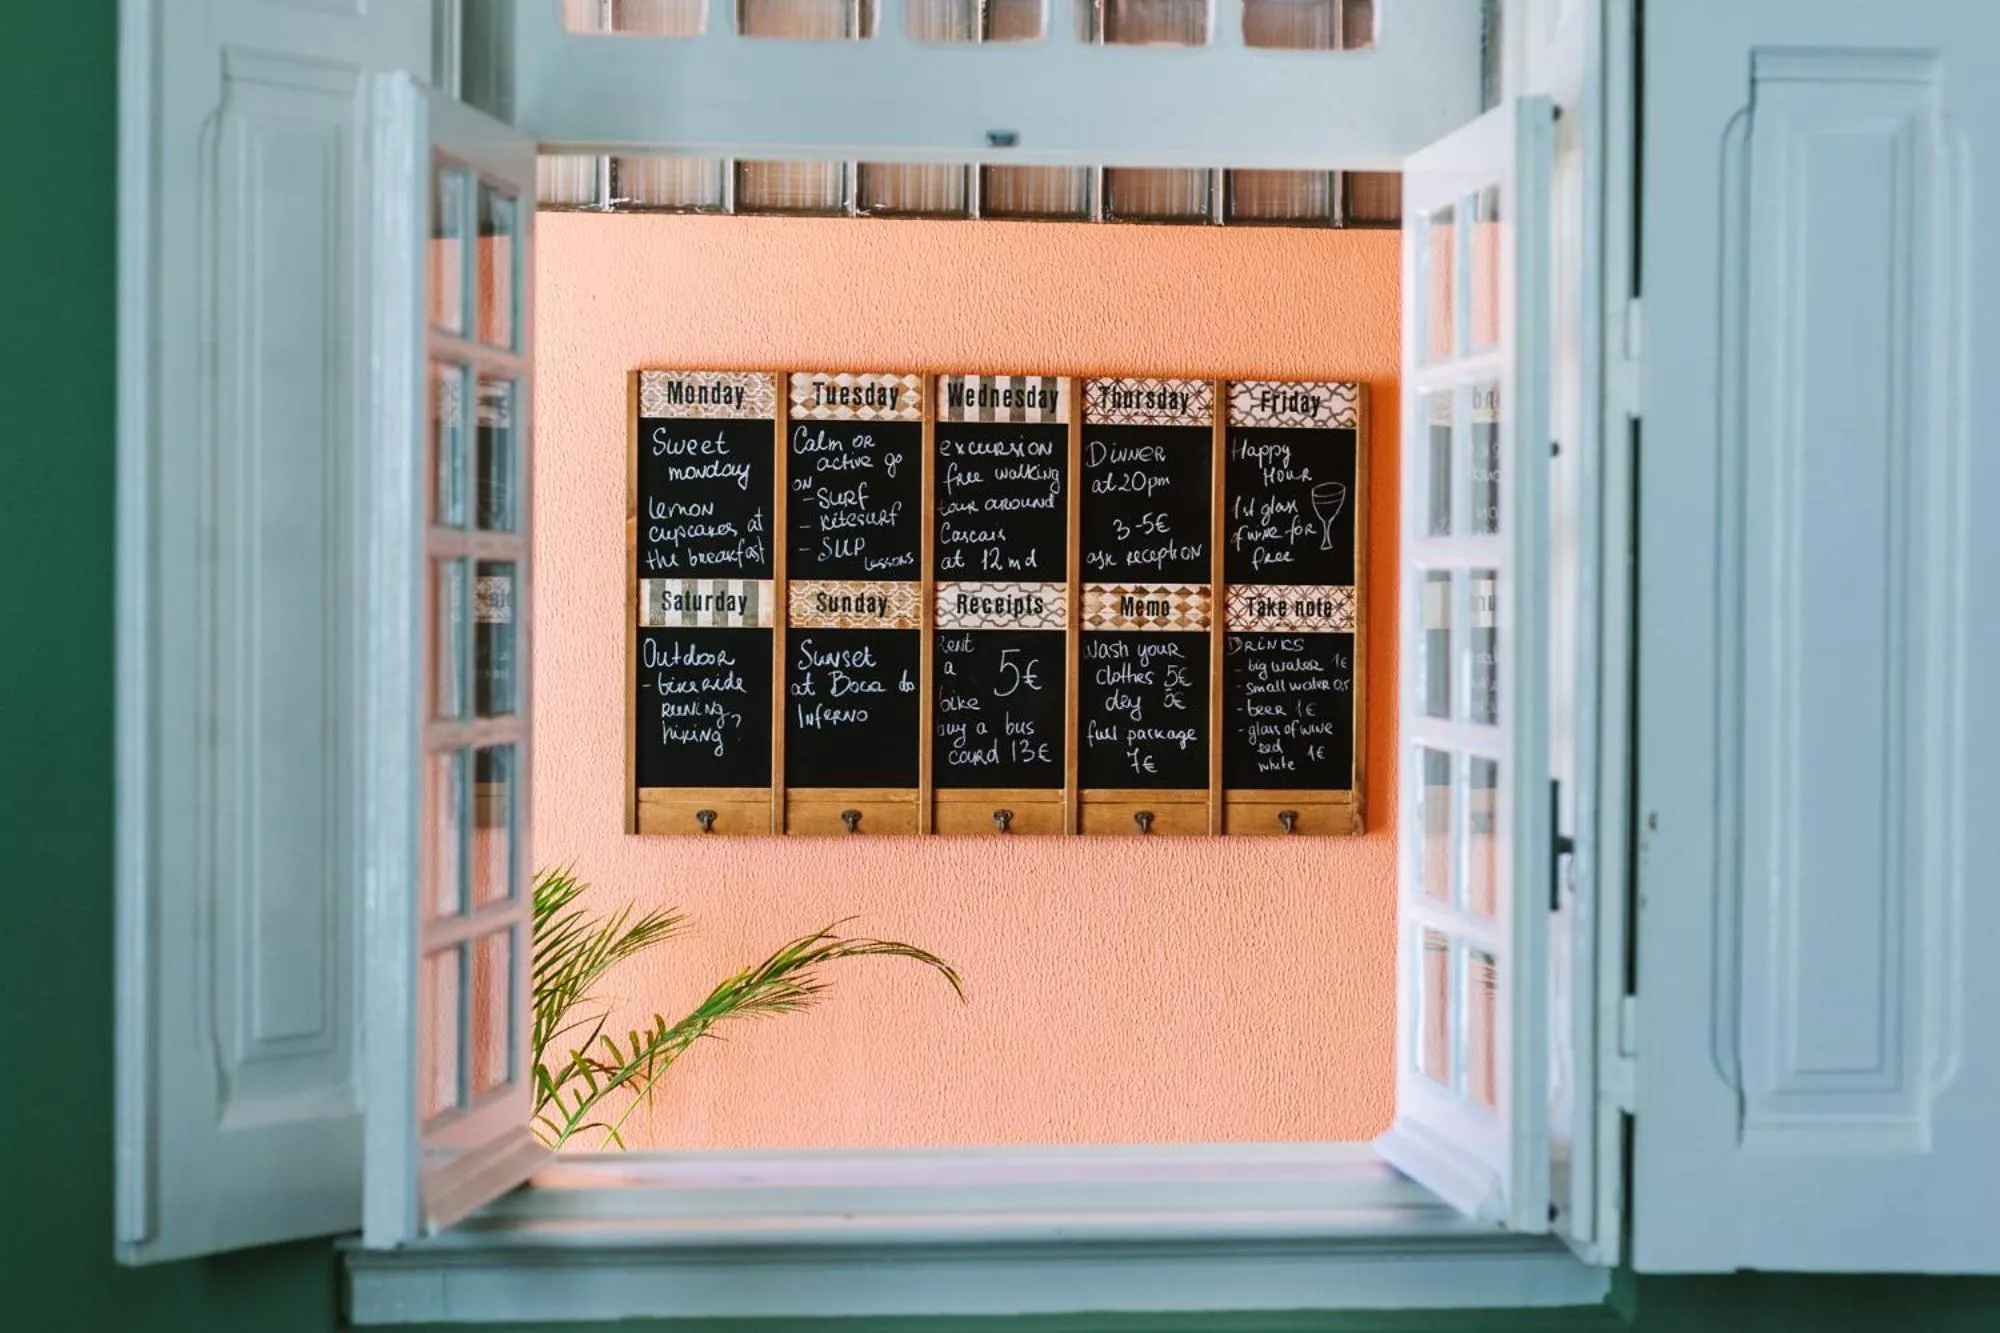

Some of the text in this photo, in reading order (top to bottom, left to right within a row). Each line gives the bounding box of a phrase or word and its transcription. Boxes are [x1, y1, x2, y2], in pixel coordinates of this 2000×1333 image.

[667, 381, 744, 409] Monday
[812, 382, 899, 410] Tuesday
[948, 382, 1059, 413] Wednesday
[1099, 385, 1189, 414] Thursday
[1261, 390, 1320, 417] Friday
[652, 427, 730, 455] Sweet
[793, 425, 843, 454] Calm
[940, 435, 1052, 457] excursion
[1232, 437, 1291, 469] Happy
[669, 460, 751, 490] monday
[817, 451, 903, 478] active go
[943, 462, 1060, 495] free walking
[1092, 473, 1118, 494] at
[817, 482, 870, 510] Surf
[984, 493, 1054, 511] around
[649, 506, 763, 547] cupcakes at
[940, 521, 1006, 544] Cascais
[1285, 515, 1317, 544] for
[645, 535, 765, 570] the breakfast
[940, 550, 965, 570] at
[981, 547, 1003, 571] 12
[1087, 540, 1202, 571] ask reception
[1252, 546, 1295, 570] free
[661, 590, 747, 616] Saturday
[816, 592, 888, 618] Sunday
[957, 594, 1044, 618] Receipts
[1120, 596, 1170, 617] Memo
[1247, 597, 1332, 618] Take note
[644, 638, 735, 668] Outdoor
[798, 639, 877, 670] Sunset
[1137, 643, 1185, 667] your
[944, 661, 957, 675] a
[1248, 658, 1267, 680] big
[1272, 658, 1324, 672] water
[658, 672, 699, 695] bike
[791, 669, 915, 697] at Boca do
[1289, 679, 1331, 692] water
[798, 703, 868, 729] Inferno
[1247, 698, 1287, 717] beer
[976, 721, 988, 735] a
[1006, 712, 1034, 736] bus
[1087, 719, 1197, 750] full package
[1248, 719, 1333, 745] glass of wine
[663, 720, 723, 756] hiking
[949, 738, 1000, 765] card
